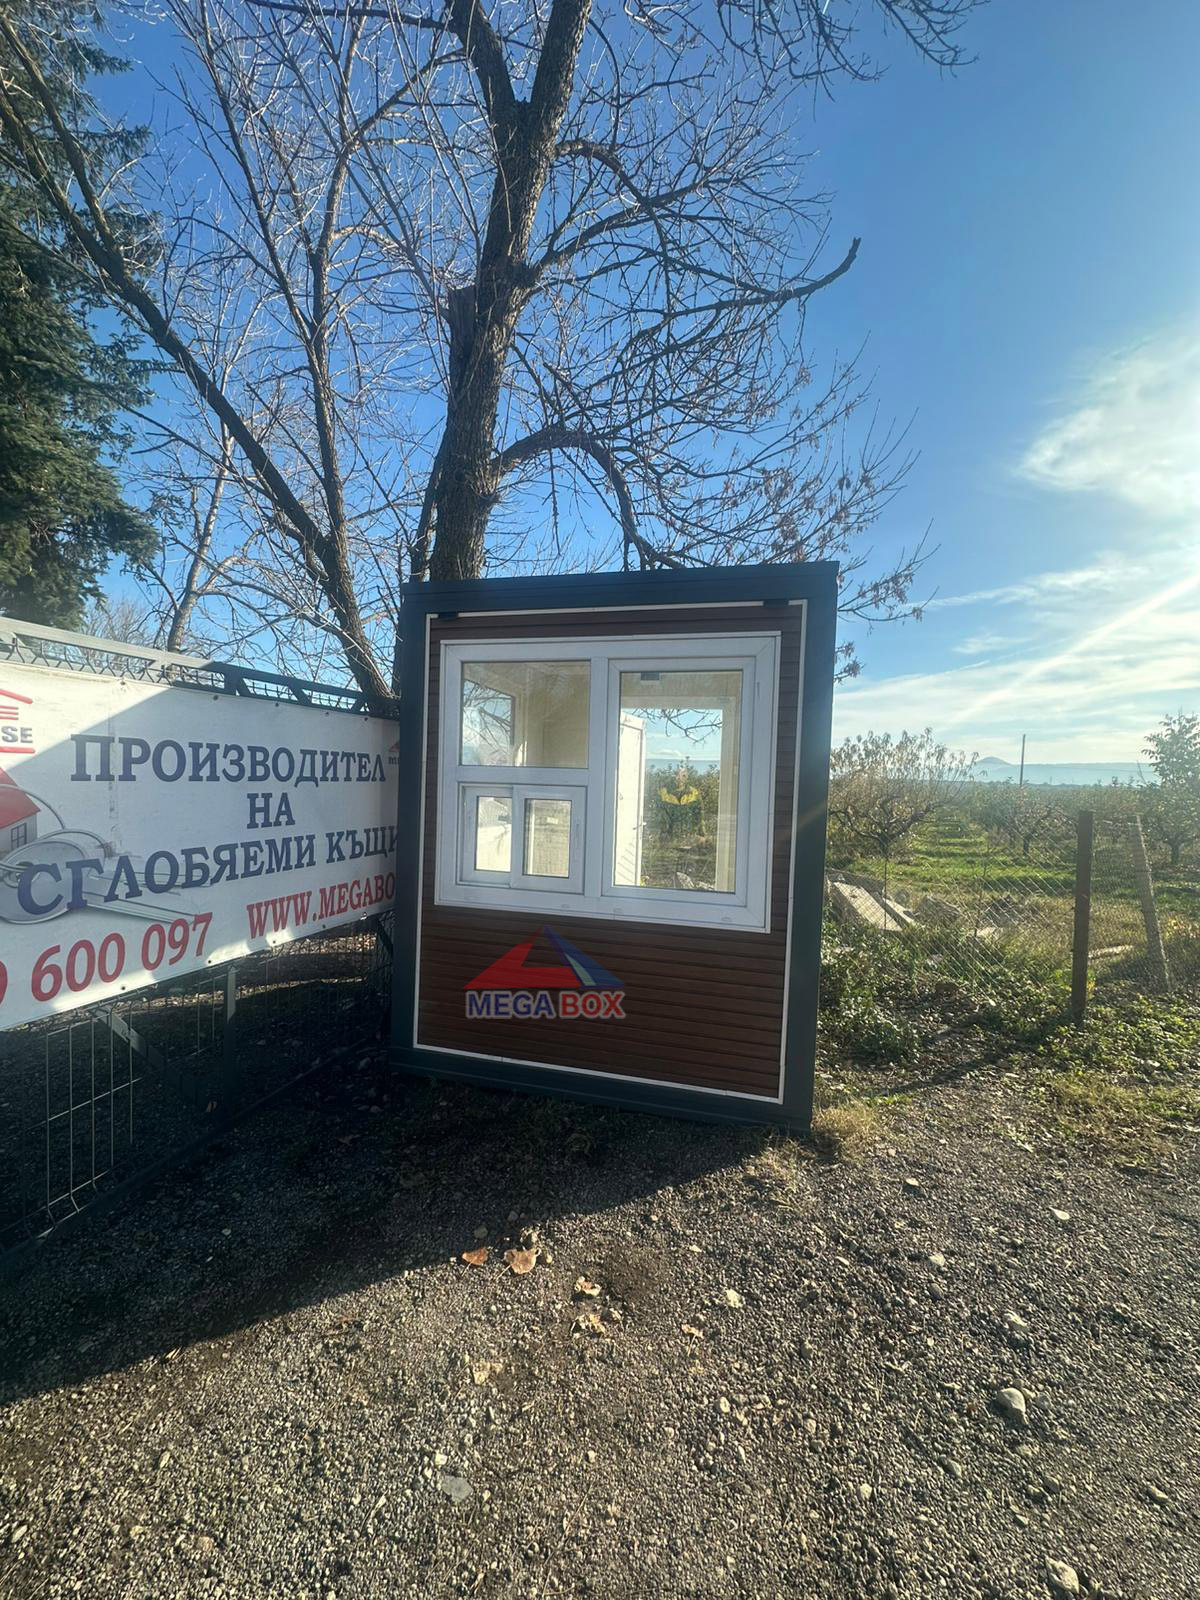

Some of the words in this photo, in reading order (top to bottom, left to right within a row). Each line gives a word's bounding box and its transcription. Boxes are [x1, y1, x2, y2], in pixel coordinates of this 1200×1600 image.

[70, 733, 386, 787] ПРОИЗВОДИТЕЛ
[246, 792, 296, 829] НА
[17, 834, 316, 915] СГЛОБЯЕМИ
[31, 932, 126, 1002] 600
[141, 912, 213, 971] 097
